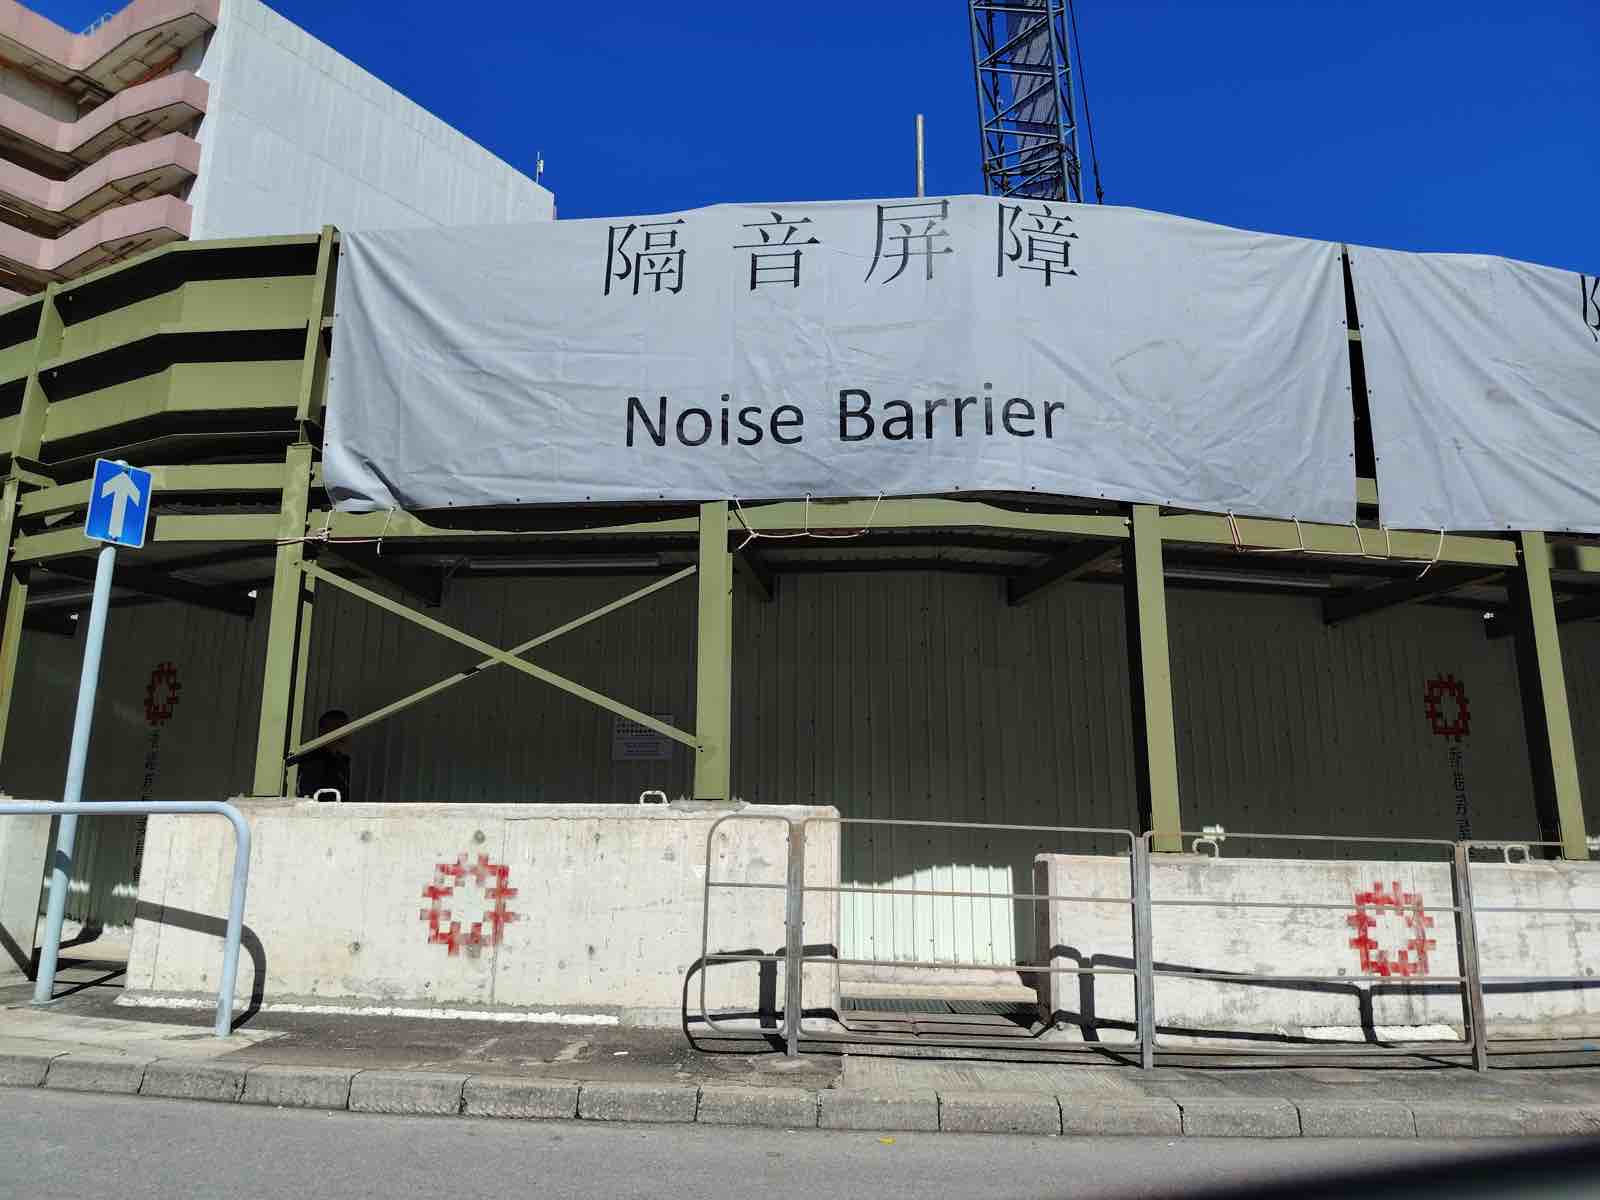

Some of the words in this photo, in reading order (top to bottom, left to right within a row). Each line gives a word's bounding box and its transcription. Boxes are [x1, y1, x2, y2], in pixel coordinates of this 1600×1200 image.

[603, 198, 1080, 297] 隔音屏障
[626, 393, 804, 448] Noise
[839, 382, 1065, 442] Barrier
